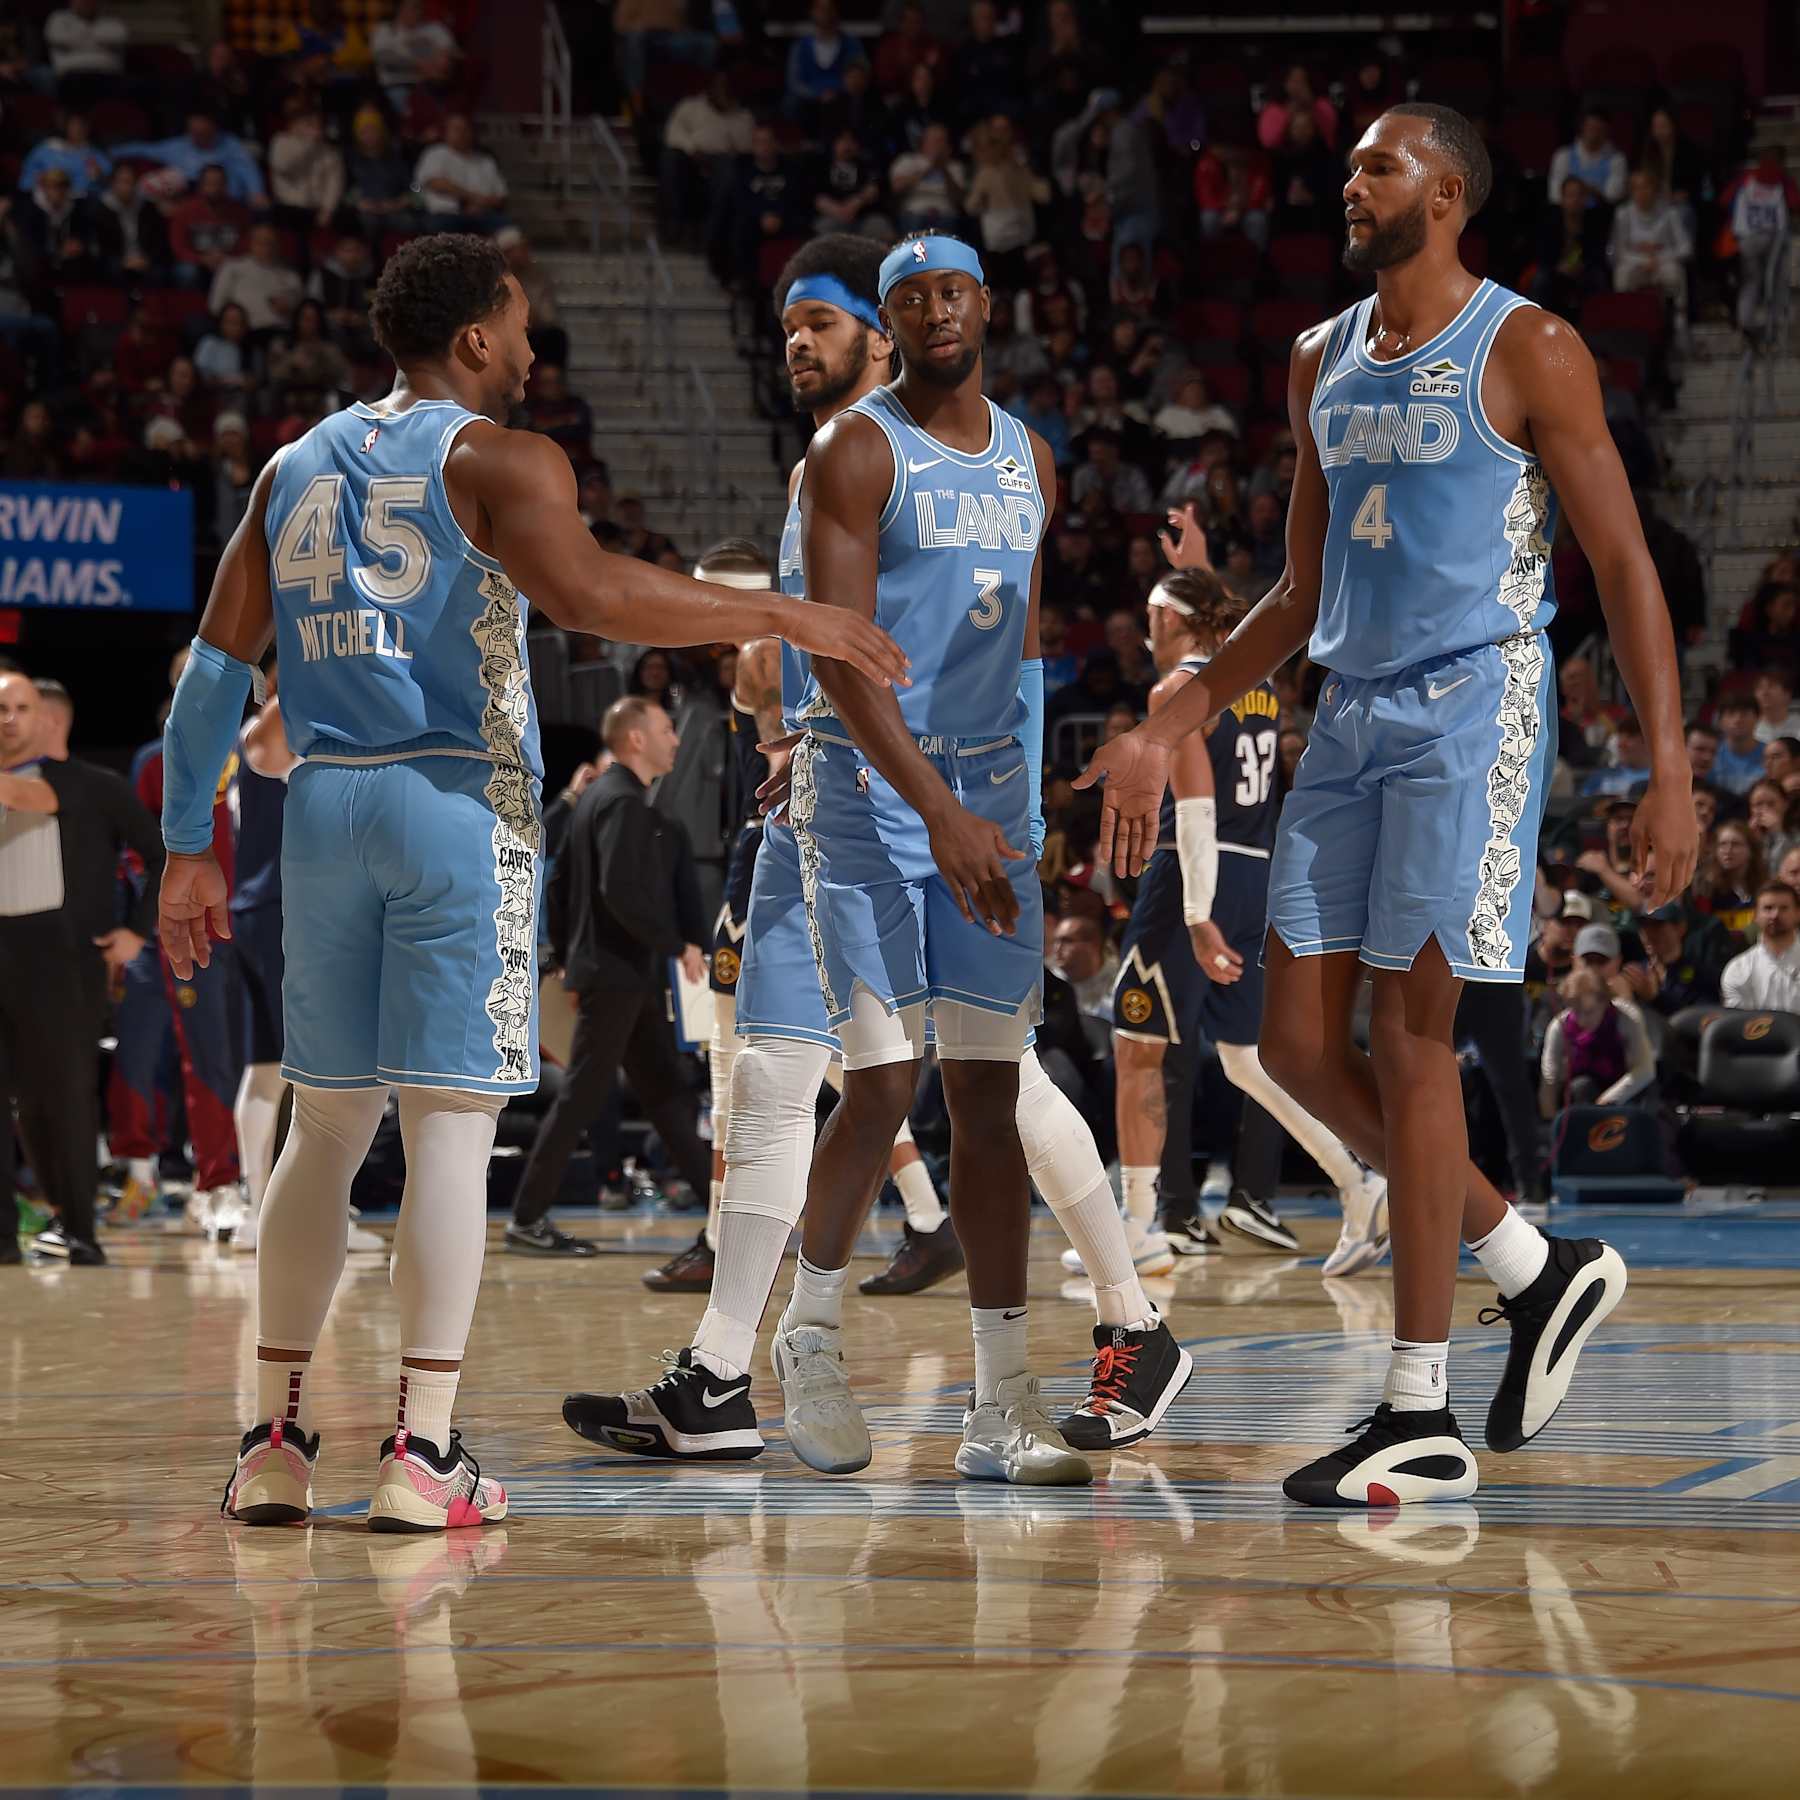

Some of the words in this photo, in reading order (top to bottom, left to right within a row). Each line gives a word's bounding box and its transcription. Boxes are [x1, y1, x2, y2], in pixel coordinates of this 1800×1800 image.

[1333, 404, 1350, 416] THE
[1412, 382, 1460, 394] CLIFFS
[1319, 403, 1460, 469] LAND
[934, 489, 956, 500] THE
[999, 477, 1031, 491] CLIFFS
[273, 473, 433, 607] 45
[914, 491, 1042, 552] LAND
[1351, 484, 1393, 549] 4
[968, 567, 1003, 631] 3
[296, 609, 414, 662] MITCHELL
[918, 735, 945, 755] CAV
[1235, 729, 1278, 807] 32
